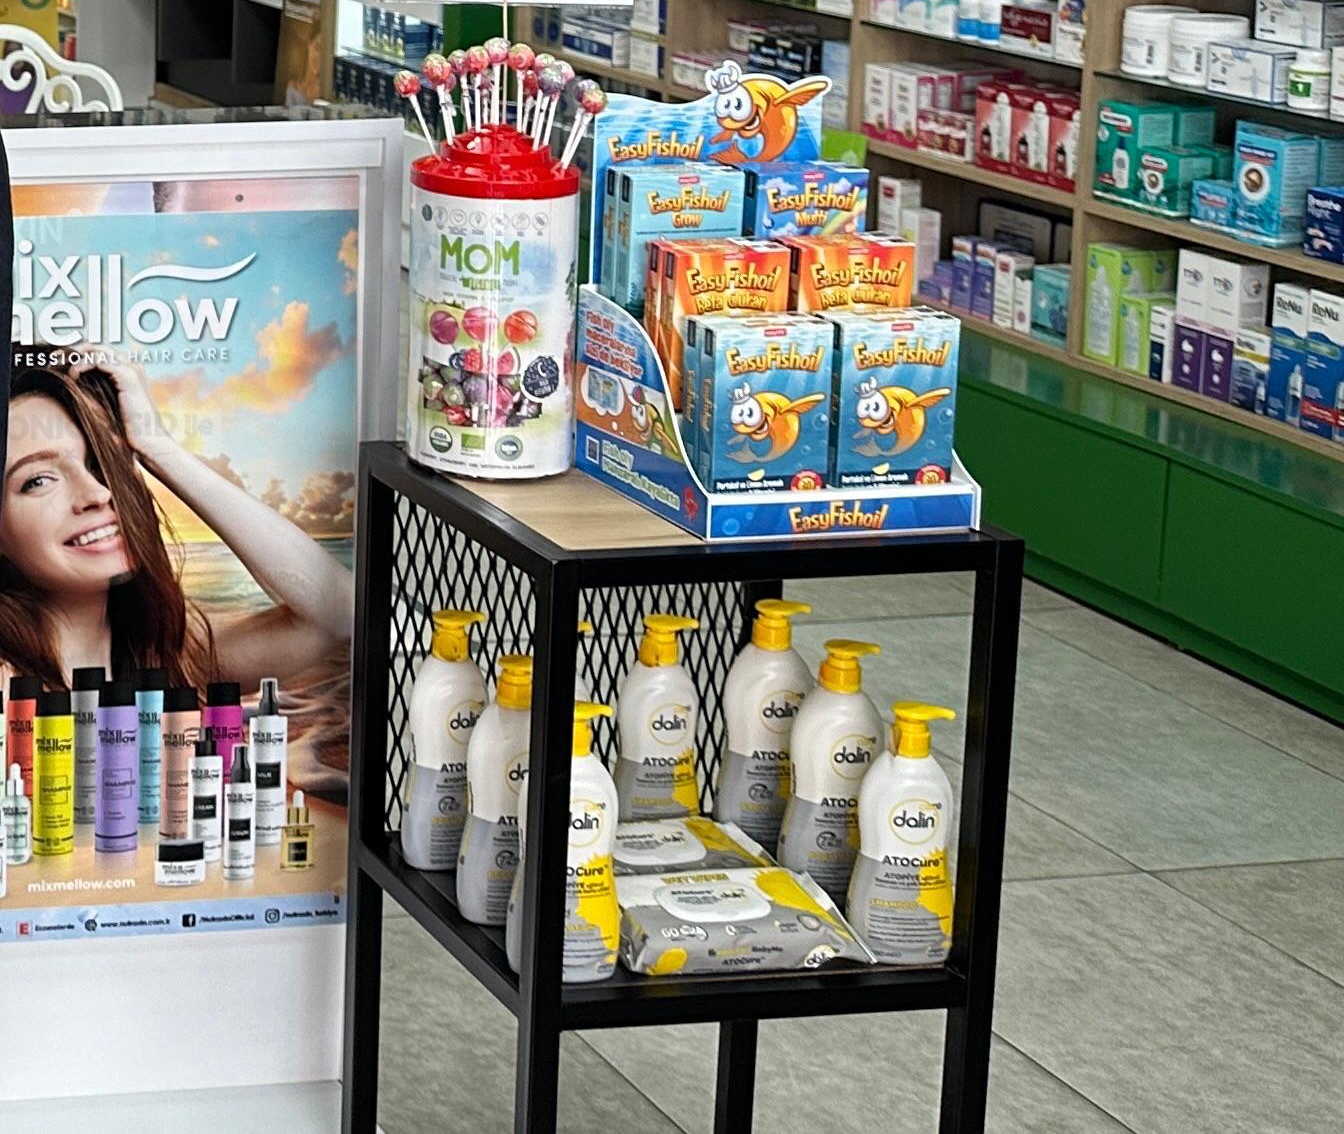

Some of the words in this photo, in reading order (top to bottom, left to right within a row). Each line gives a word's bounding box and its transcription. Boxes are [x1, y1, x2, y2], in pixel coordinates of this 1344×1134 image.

[608, 130, 705, 163] EasyFishoil
[647, 186, 731, 214] EasyFishoil
[767, 181, 859, 214] EasyFishoil
[672, 213, 703, 227] Grow
[440, 233, 520, 276] MOM
[18, 239, 82, 300] ix
[687, 260, 783, 295] EasyFishoil
[810, 256, 905, 291] EasyFishoil
[696, 291, 726, 315] Beta
[820, 288, 849, 309] Beta
[1276, 296, 1303, 315] ReNu
[1313, 303, 1340, 323] ReNu
[15, 350, 117, 368] FESSIONAL
[128, 350, 173, 364] HAIR
[181, 347, 229, 362] CARE
[725, 343, 825, 376] EasyFishoil
[853, 338, 951, 371] EasyFishoil
[788, 501, 889, 533] EasyFishoil
[652, 714, 687, 732] dalin
[752, 751, 790, 761] ATOC
[834, 746, 871, 764] dalin
[440, 762, 467, 774] ATOC
[821, 798, 857, 808] ATOC
[894, 810, 935, 829] dalin
[566, 865, 605, 877] OCure
[27, 875, 136, 894] mixmellow.com
